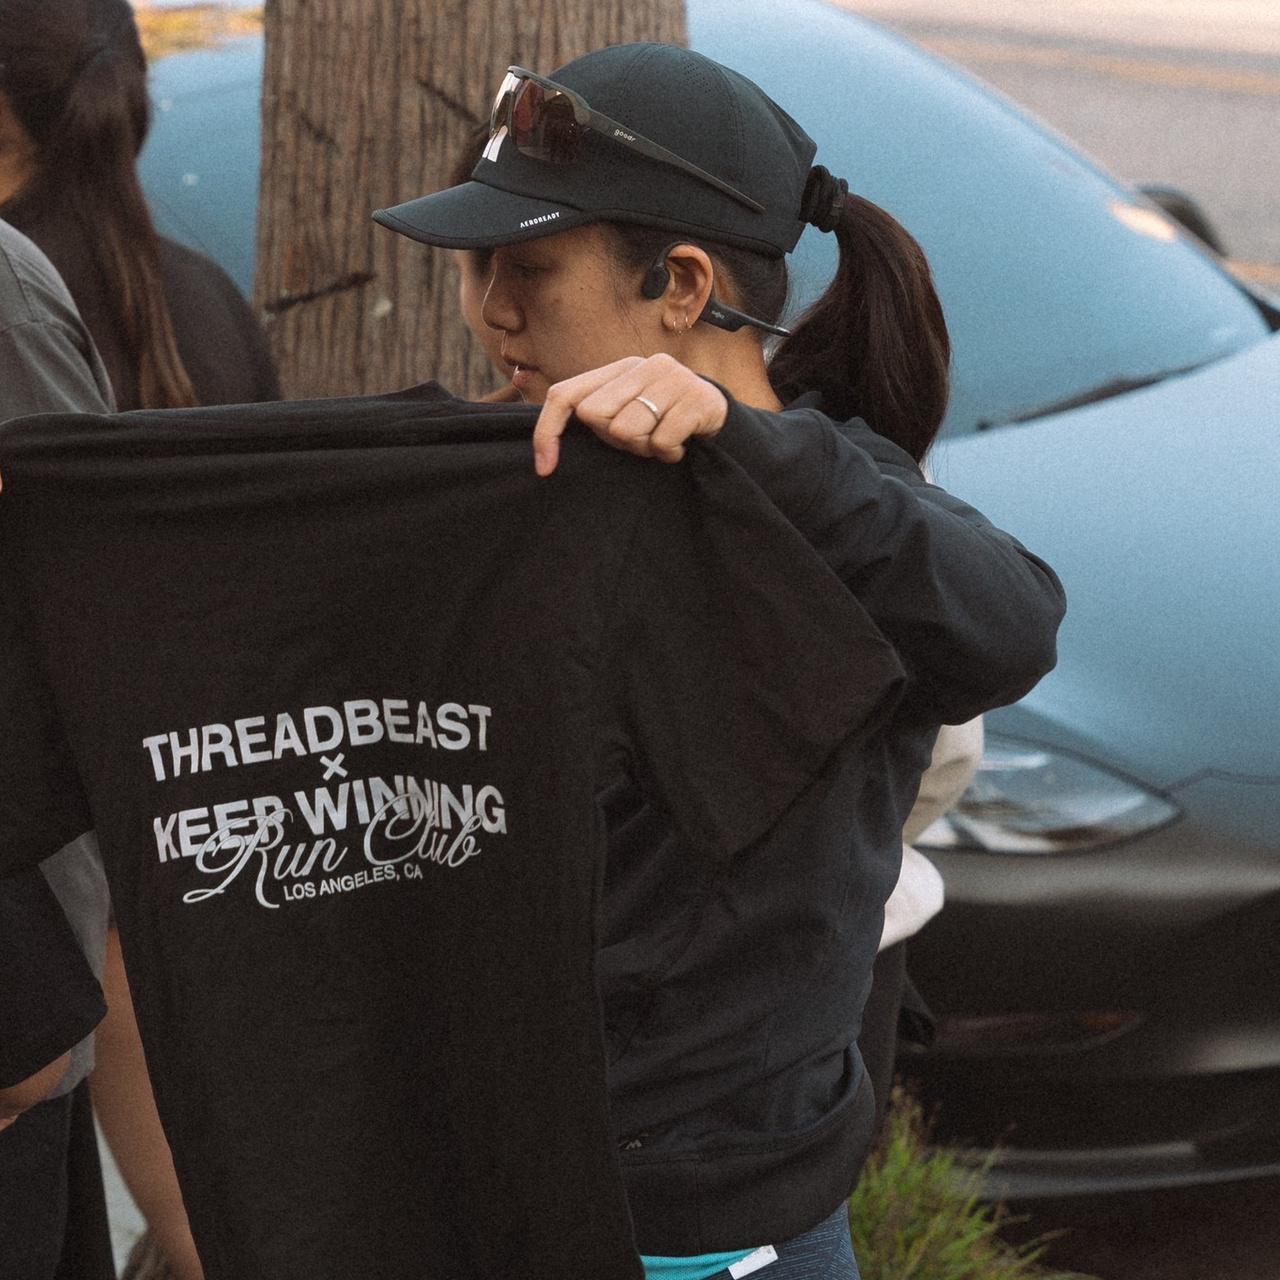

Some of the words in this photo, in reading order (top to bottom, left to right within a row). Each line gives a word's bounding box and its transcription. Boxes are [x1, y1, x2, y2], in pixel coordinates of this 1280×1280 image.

[613, 129, 636, 142] goodr
[520, 211, 560, 229] AEROREADY
[142, 698, 491, 781] THREADBEAST
[153, 795, 285, 863] KEEP
[294, 774, 508, 835] WINNING
[182, 808, 348, 908] Run
[363, 792, 483, 868] Club
[283, 881, 316, 901] LOS
[319, 863, 401, 897] ANGELES,
[403, 862, 424, 881] CA
